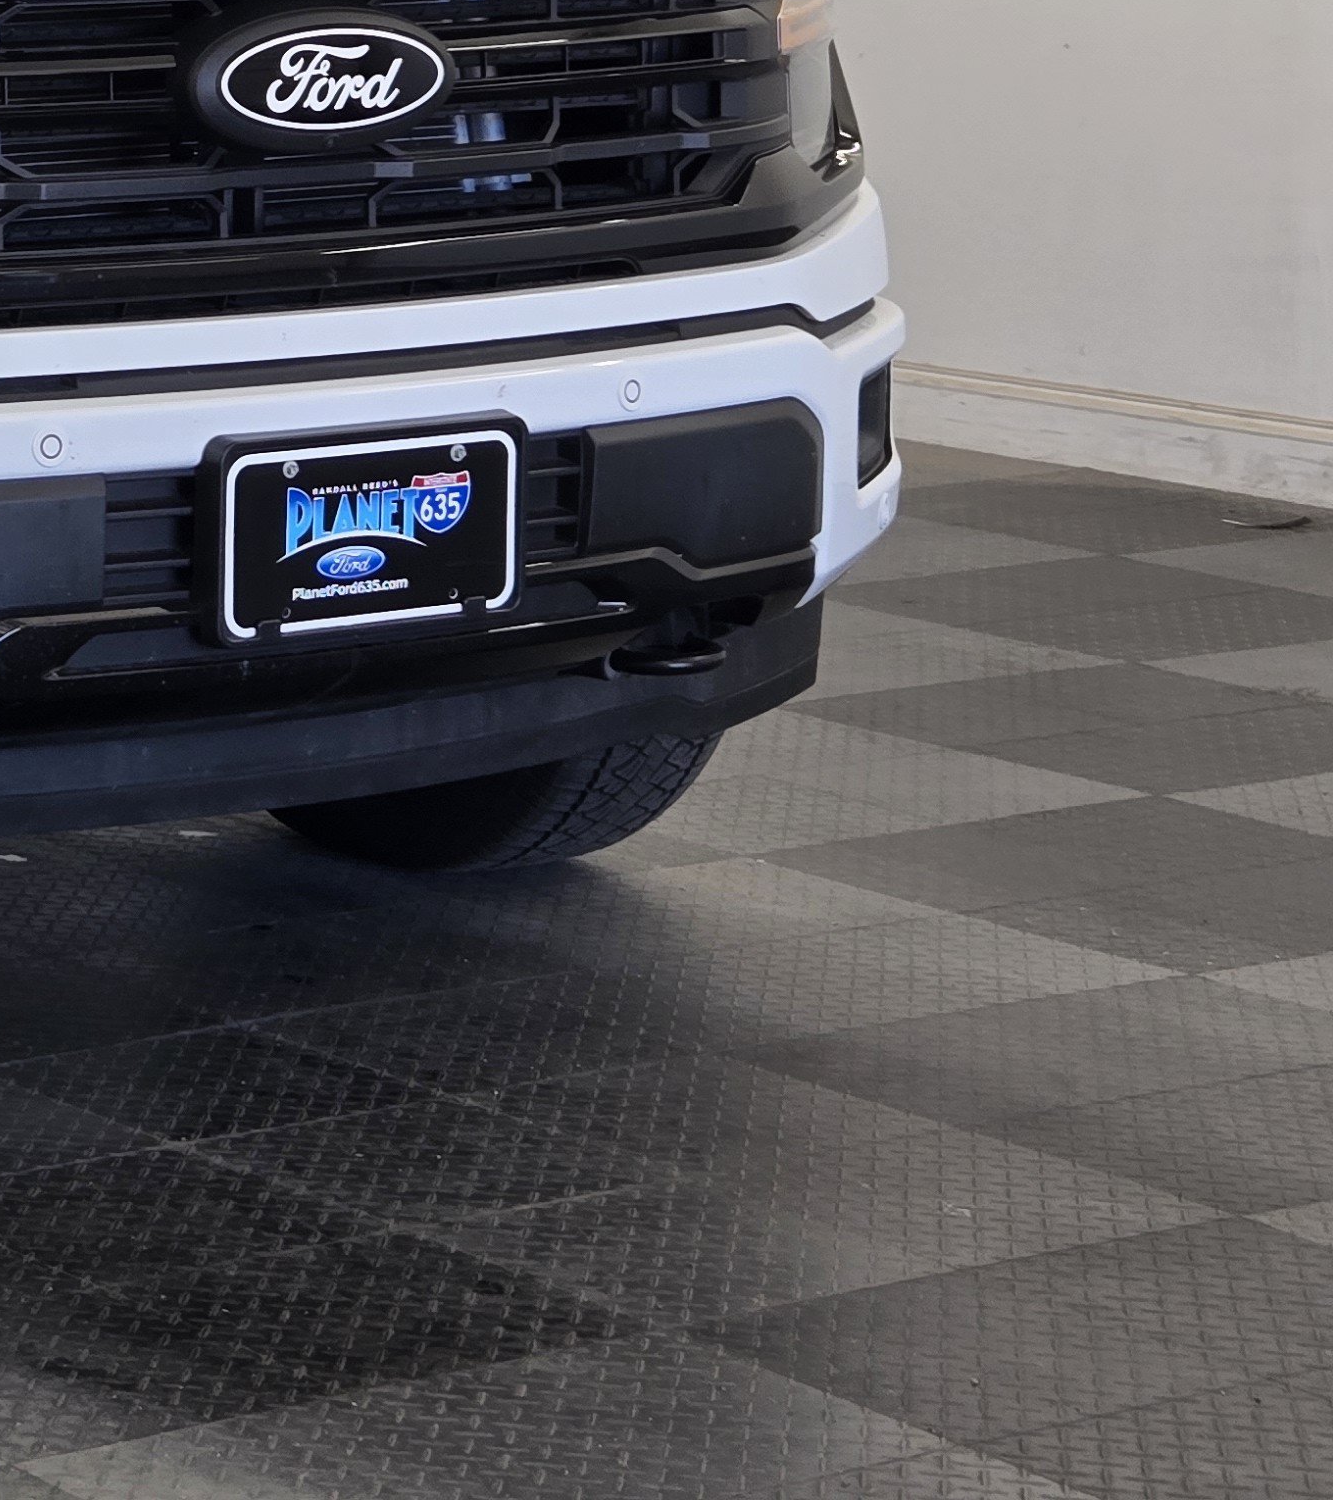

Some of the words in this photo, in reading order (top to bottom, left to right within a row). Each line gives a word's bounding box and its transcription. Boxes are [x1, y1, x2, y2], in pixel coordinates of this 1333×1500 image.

[266, 43, 404, 114] Ford
[286, 487, 421, 555] PLANET
[419, 491, 461, 522] 635
[329, 553, 373, 575] Ford
[292, 578, 409, 601] PlanetFord635.com
